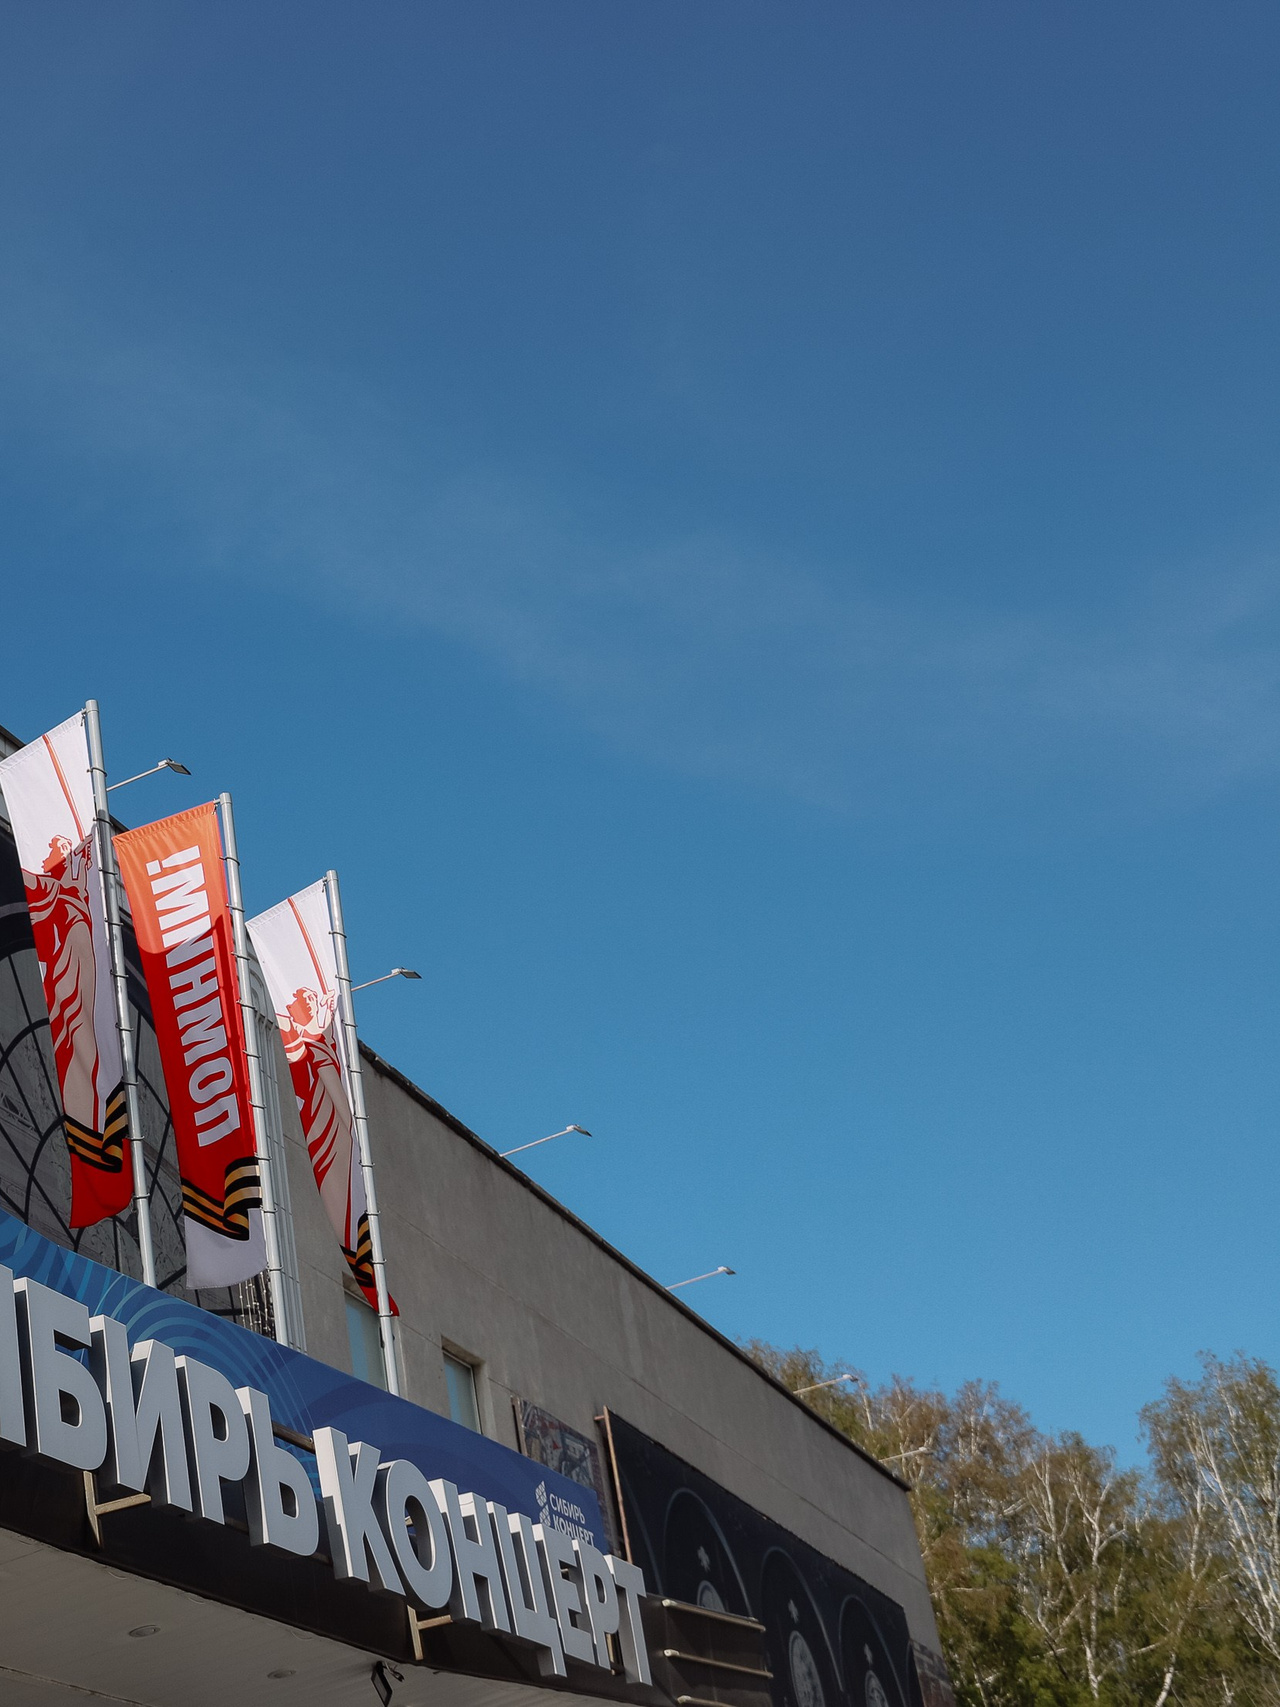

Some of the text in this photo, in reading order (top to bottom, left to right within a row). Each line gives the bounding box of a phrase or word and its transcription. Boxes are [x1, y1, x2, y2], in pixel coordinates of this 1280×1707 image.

[550, 1493, 585, 1524] СИБИРЬ
[553, 1514, 594, 1547] КОНЦЕРТ
[312, 1426, 653, 1686] КОНЦЕРТ
